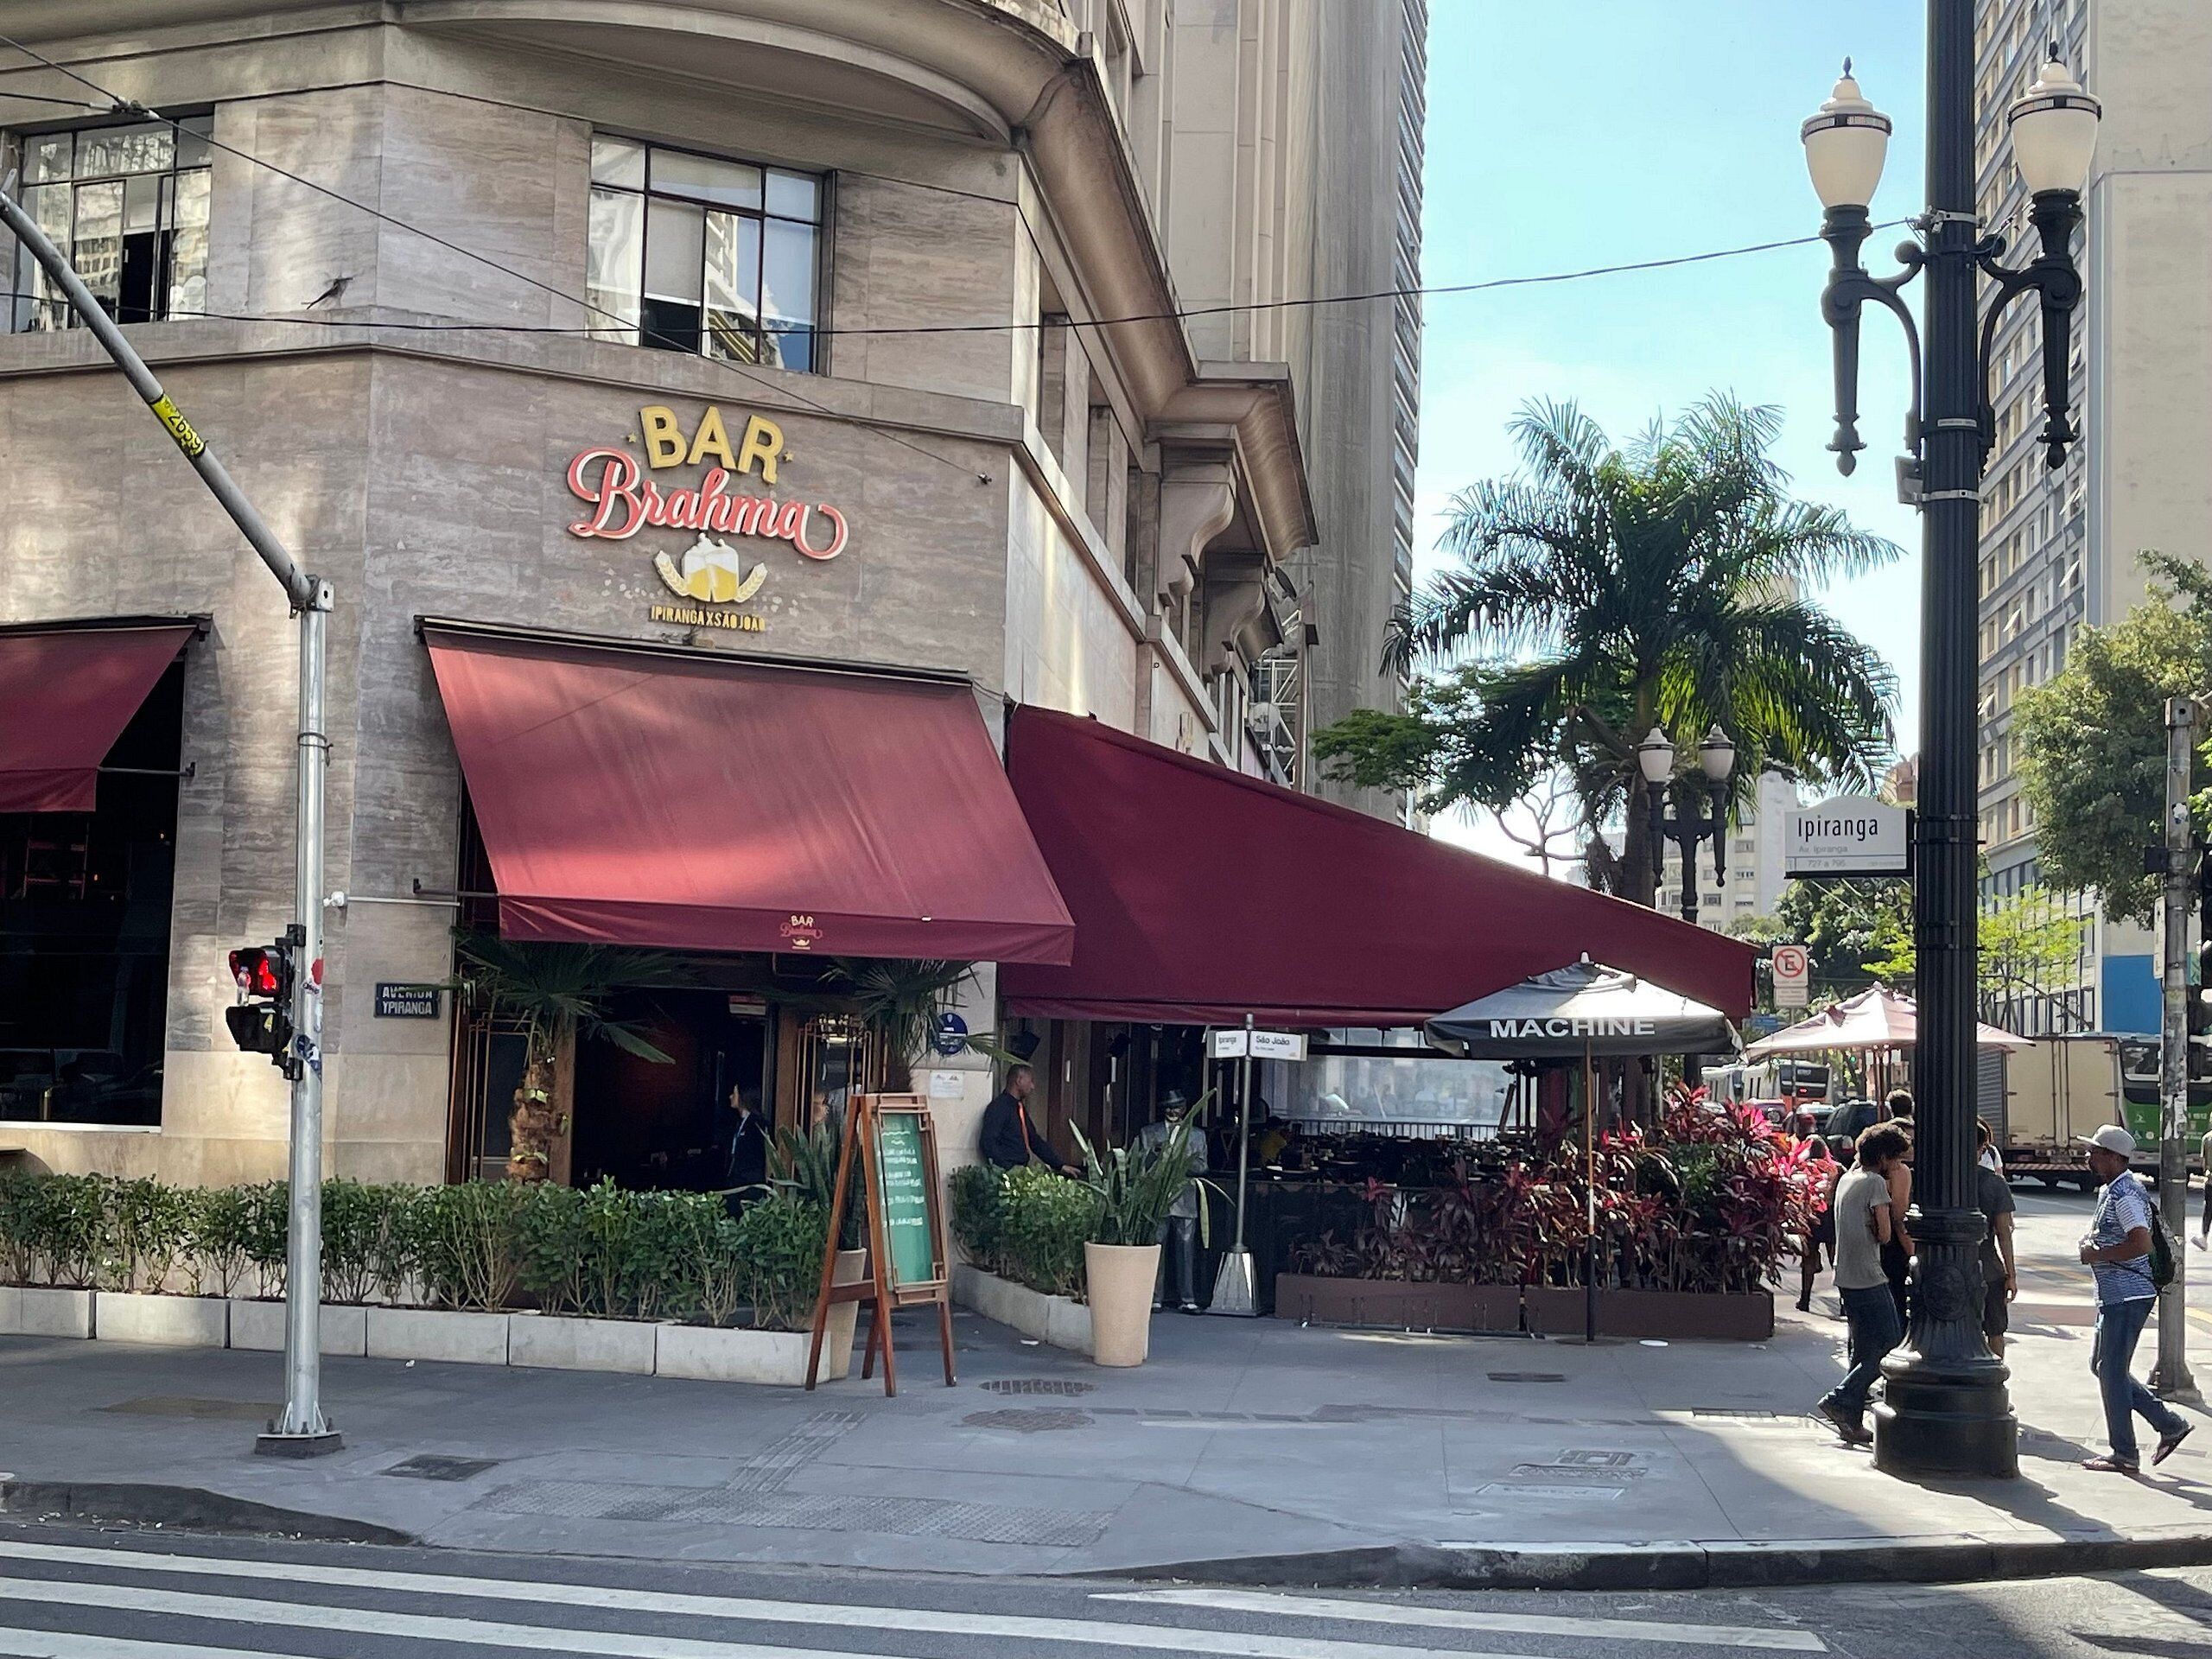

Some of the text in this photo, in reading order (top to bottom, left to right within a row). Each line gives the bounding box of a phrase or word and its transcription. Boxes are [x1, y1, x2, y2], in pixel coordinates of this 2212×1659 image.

[639, 404, 785, 485] BAR
[567, 446, 849, 561] Brahma
[651, 606, 704, 625] IPIRANGA
[1797, 815, 1878, 842] Ipiranga
[791, 914, 814, 928] BAR
[382, 1001, 433, 1014] YPIRANGA
[1490, 1018, 1655, 1038] MACHINE
[1255, 1035, 1270, 1045] São
[1272, 1037, 1290, 1046] João
